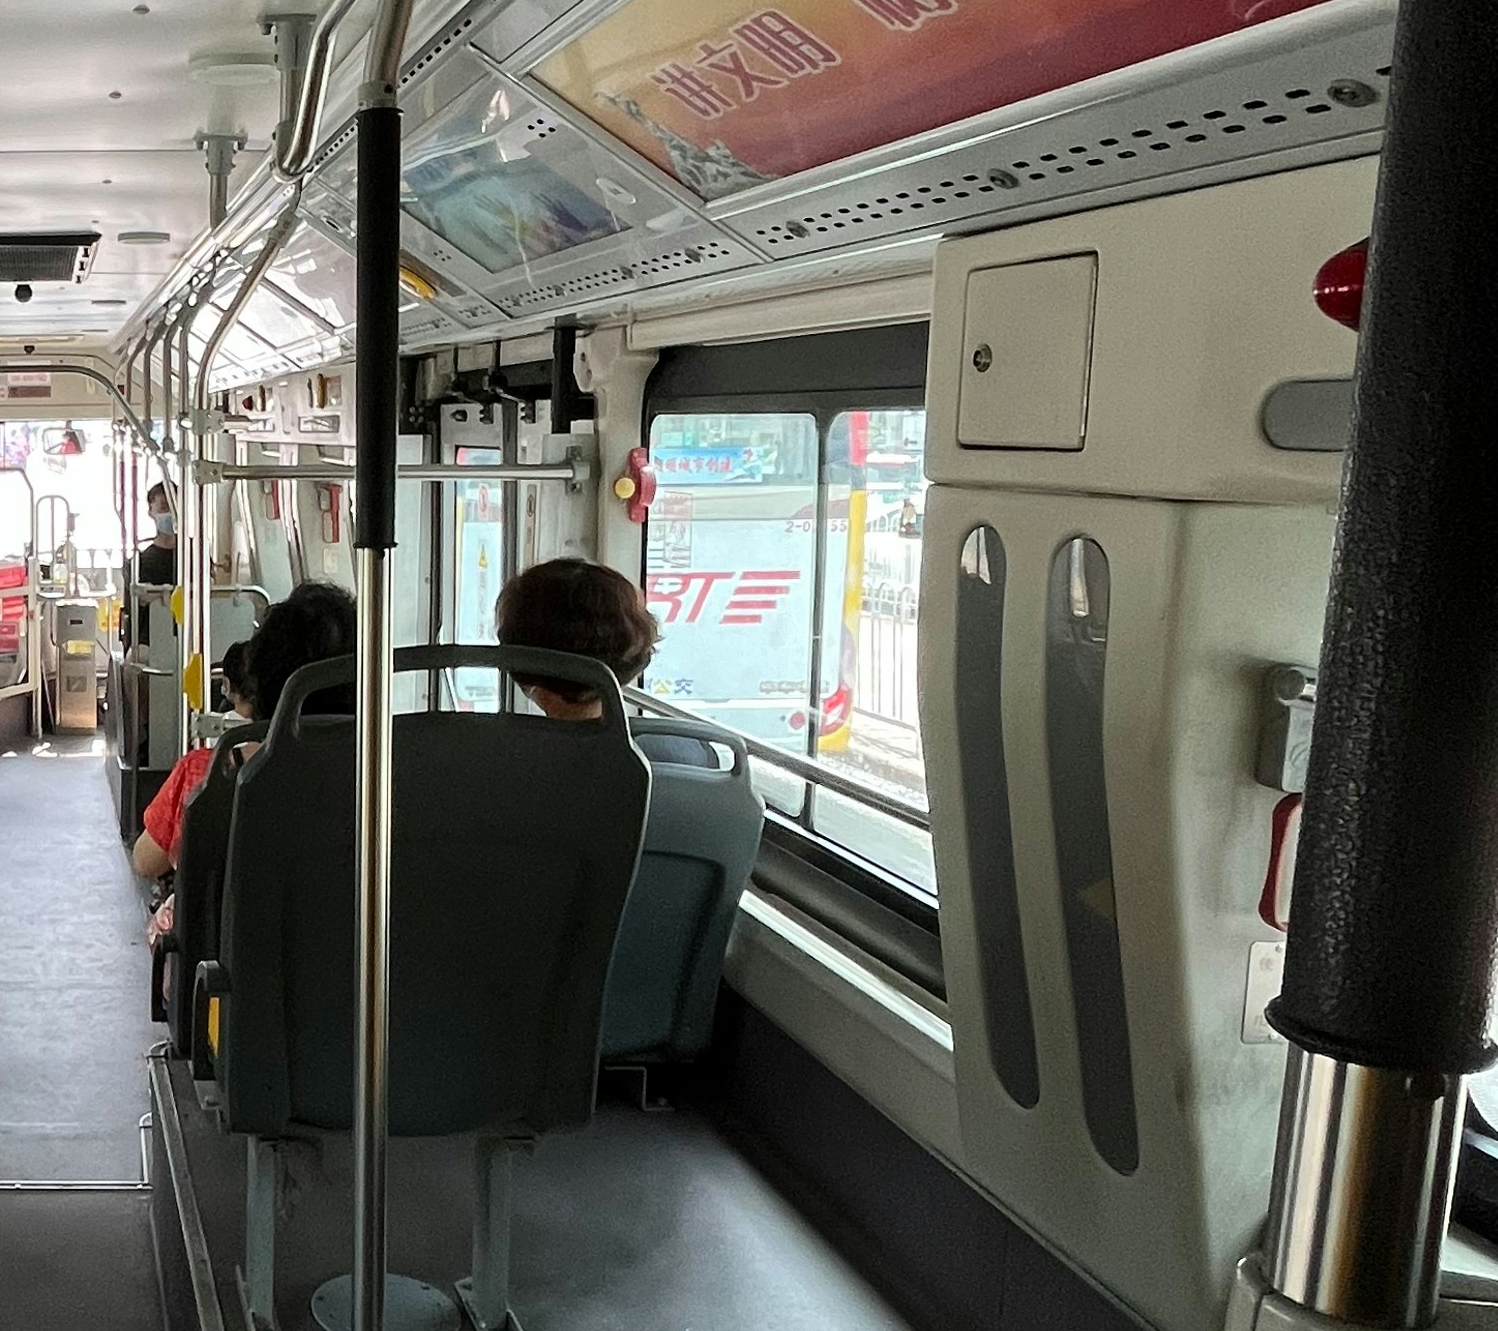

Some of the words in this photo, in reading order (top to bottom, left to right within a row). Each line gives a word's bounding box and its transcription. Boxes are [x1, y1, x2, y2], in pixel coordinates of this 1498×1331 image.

[651, 10, 841, 118] 讲文明
[646, 678, 693, 694] 公交
